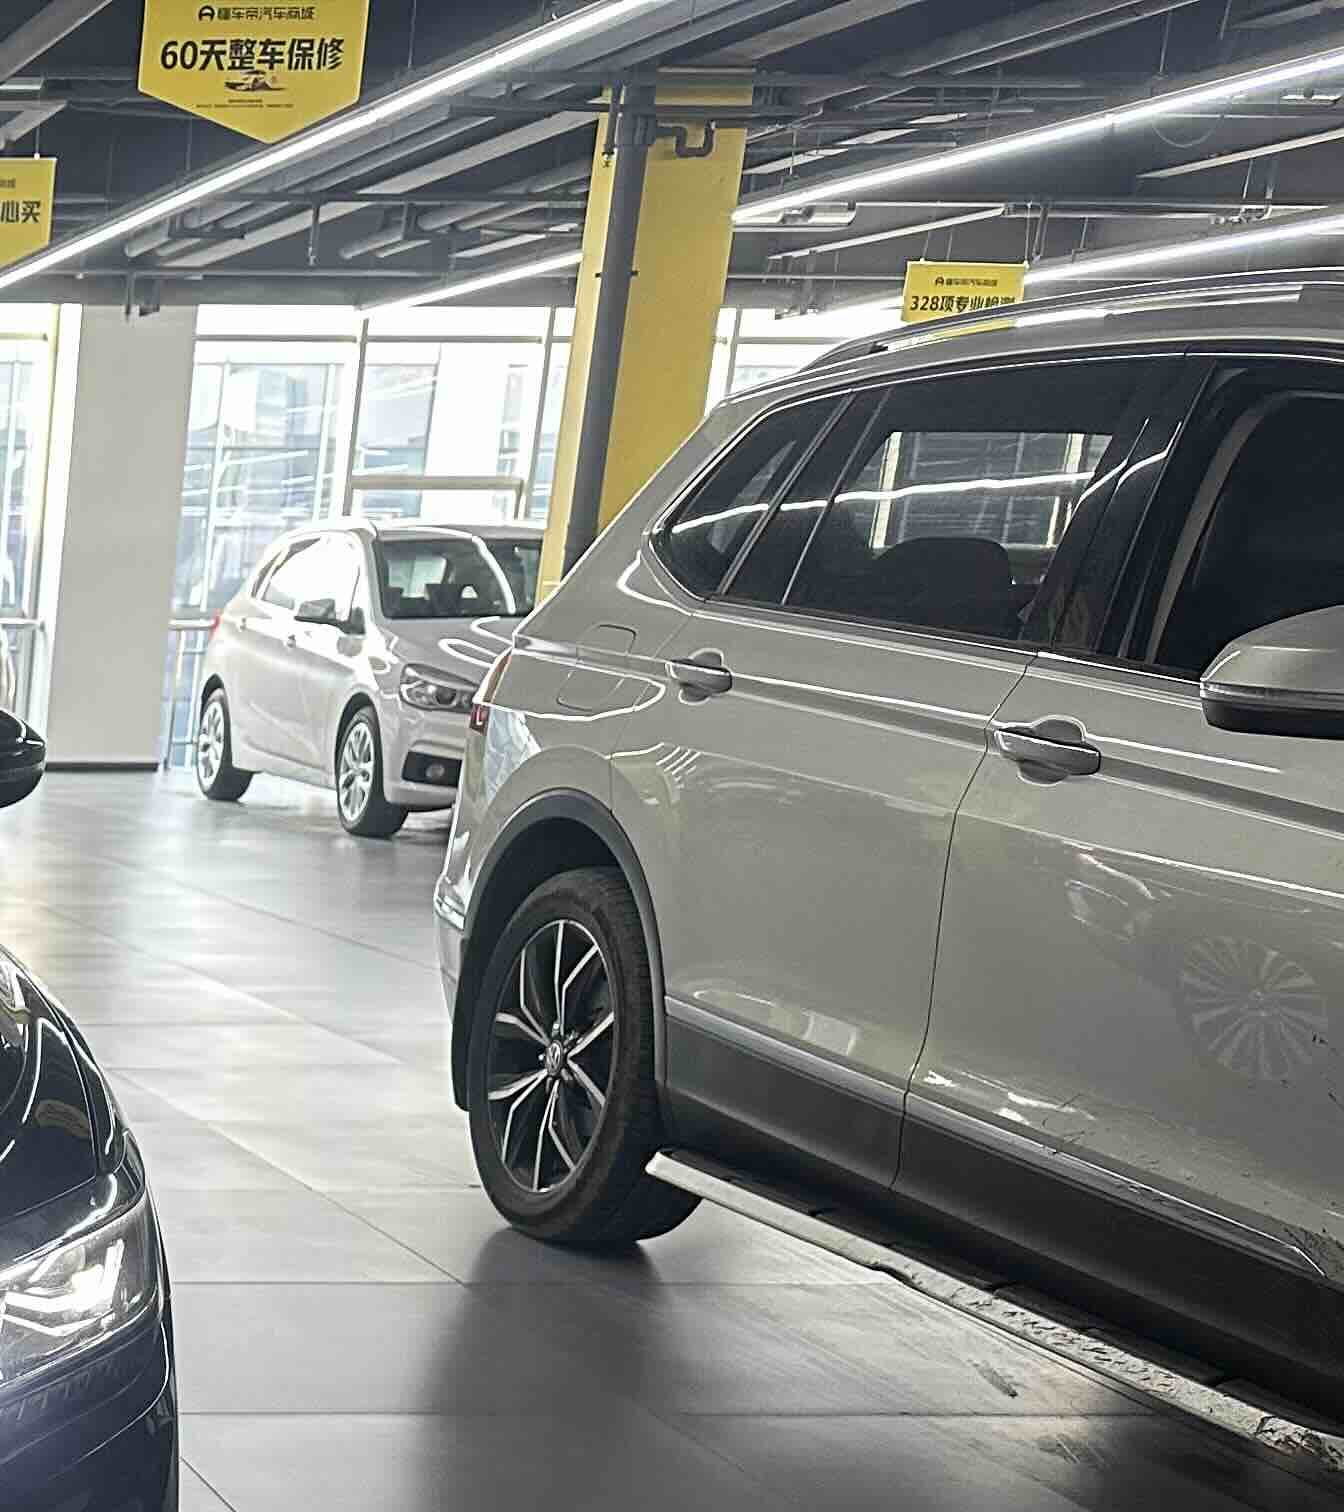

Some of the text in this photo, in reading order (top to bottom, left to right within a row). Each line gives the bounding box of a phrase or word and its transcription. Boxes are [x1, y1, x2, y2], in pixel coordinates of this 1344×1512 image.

[161, 37, 345, 71] 60天整车保修
